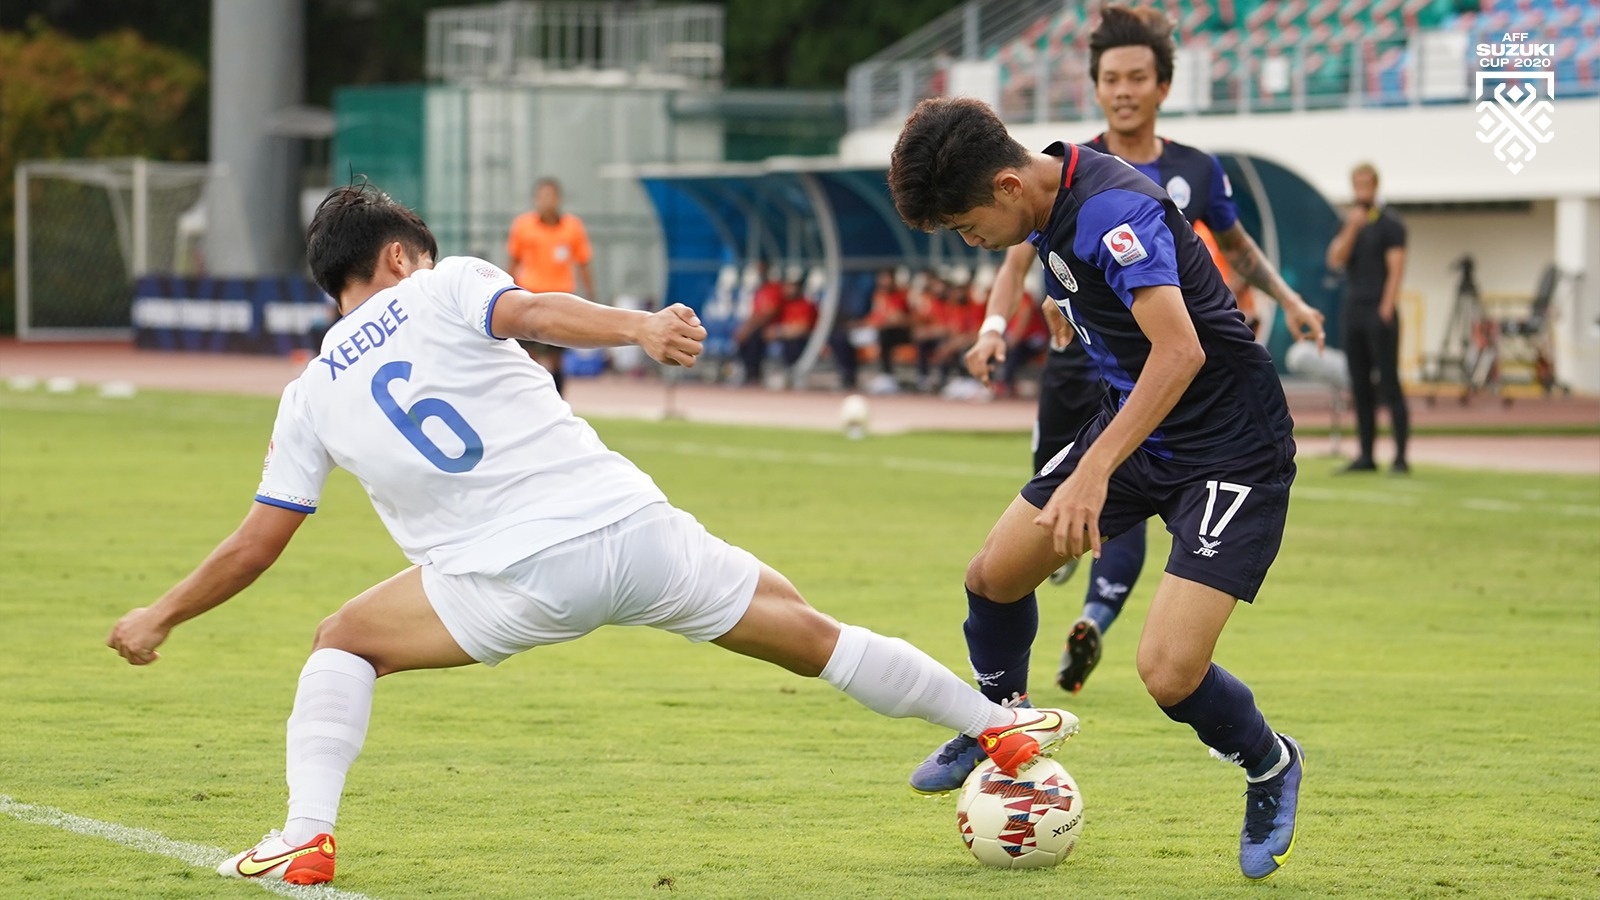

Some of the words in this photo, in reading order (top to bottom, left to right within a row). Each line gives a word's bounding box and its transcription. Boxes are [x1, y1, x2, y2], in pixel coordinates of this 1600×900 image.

[319, 299, 409, 381] XEEDEE
[371, 361, 484, 474] 6
[1199, 480, 1252, 537] 17
